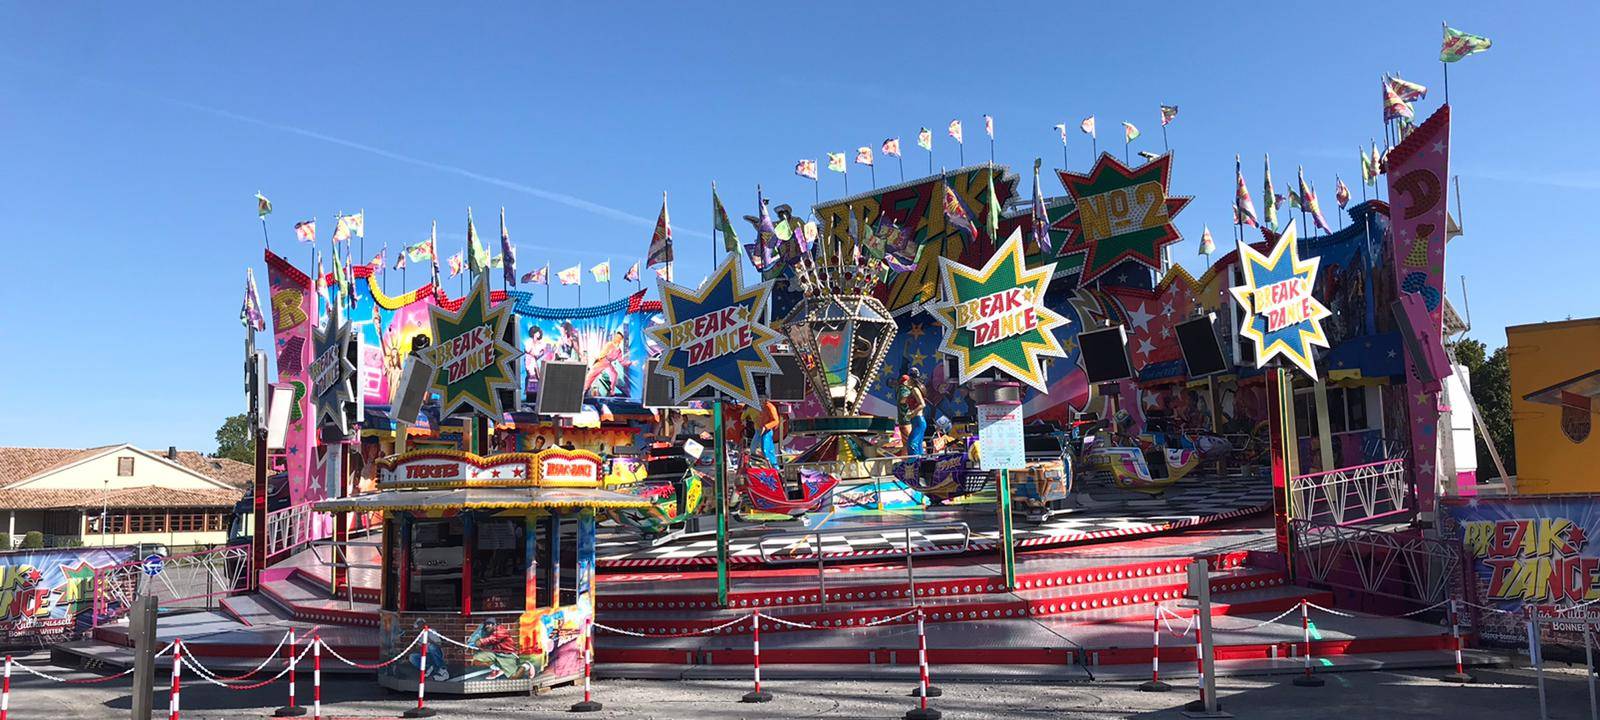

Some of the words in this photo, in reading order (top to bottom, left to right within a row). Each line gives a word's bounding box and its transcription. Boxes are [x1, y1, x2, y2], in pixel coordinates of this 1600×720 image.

[958, 289, 1022, 326] BREAK
[1256, 279, 1300, 311] BREAK
[672, 308, 737, 347] BREAK
[971, 307, 1036, 344] DANCE
[1267, 298, 1310, 330] DANCE
[437, 328, 484, 366] BREAK
[447, 343, 493, 382] DANCE
[687, 325, 750, 365] DANCE
[406, 464, 459, 478] TICKETS
[1464, 518, 1579, 558] BREAK
[1484, 556, 1600, 602] DANCE
[0, 587, 51, 619] NCE
